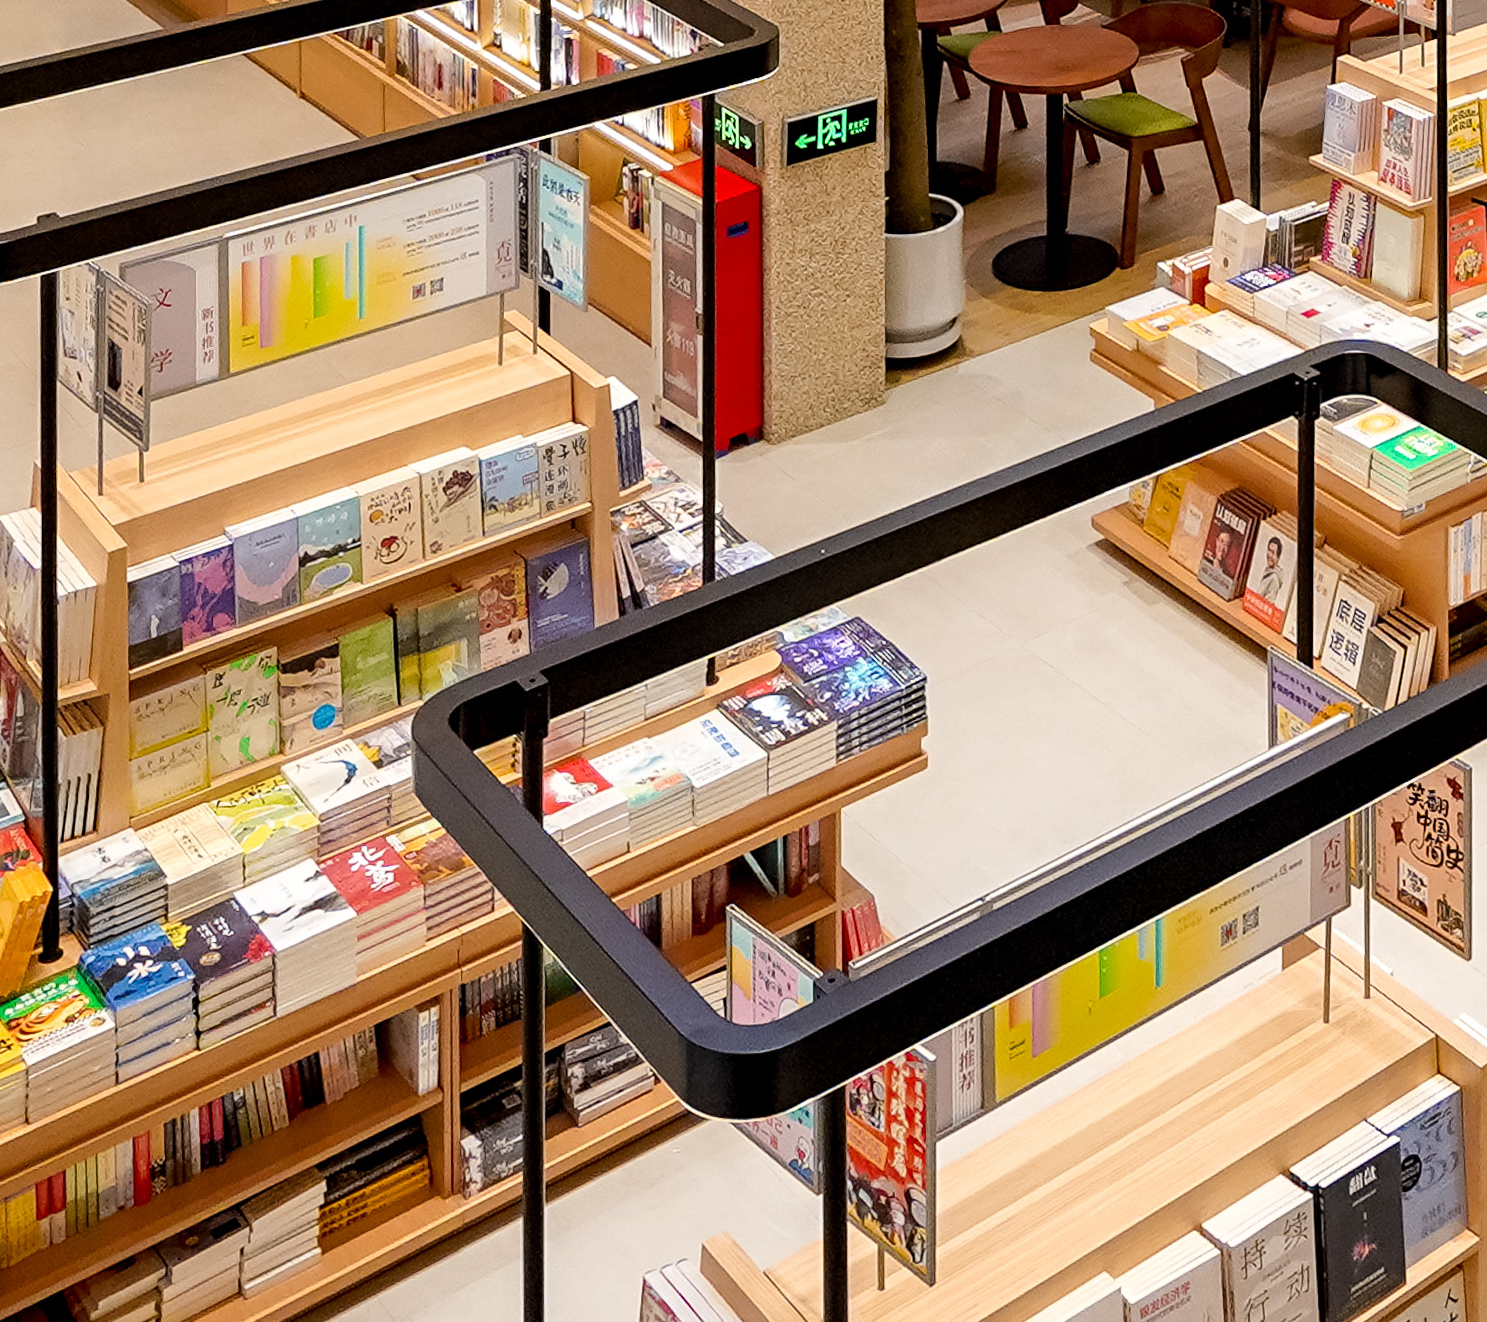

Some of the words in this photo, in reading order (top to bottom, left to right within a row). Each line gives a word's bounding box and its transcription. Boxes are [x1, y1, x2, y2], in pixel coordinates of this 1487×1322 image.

[1338, 599, 1373, 632] 底层
[1328, 629, 1363, 666] 逻辑
[1405, 782, 1451, 817] 笑翻
[1415, 808, 1452, 838] 中国
[1423, 832, 1467, 873] 简史
